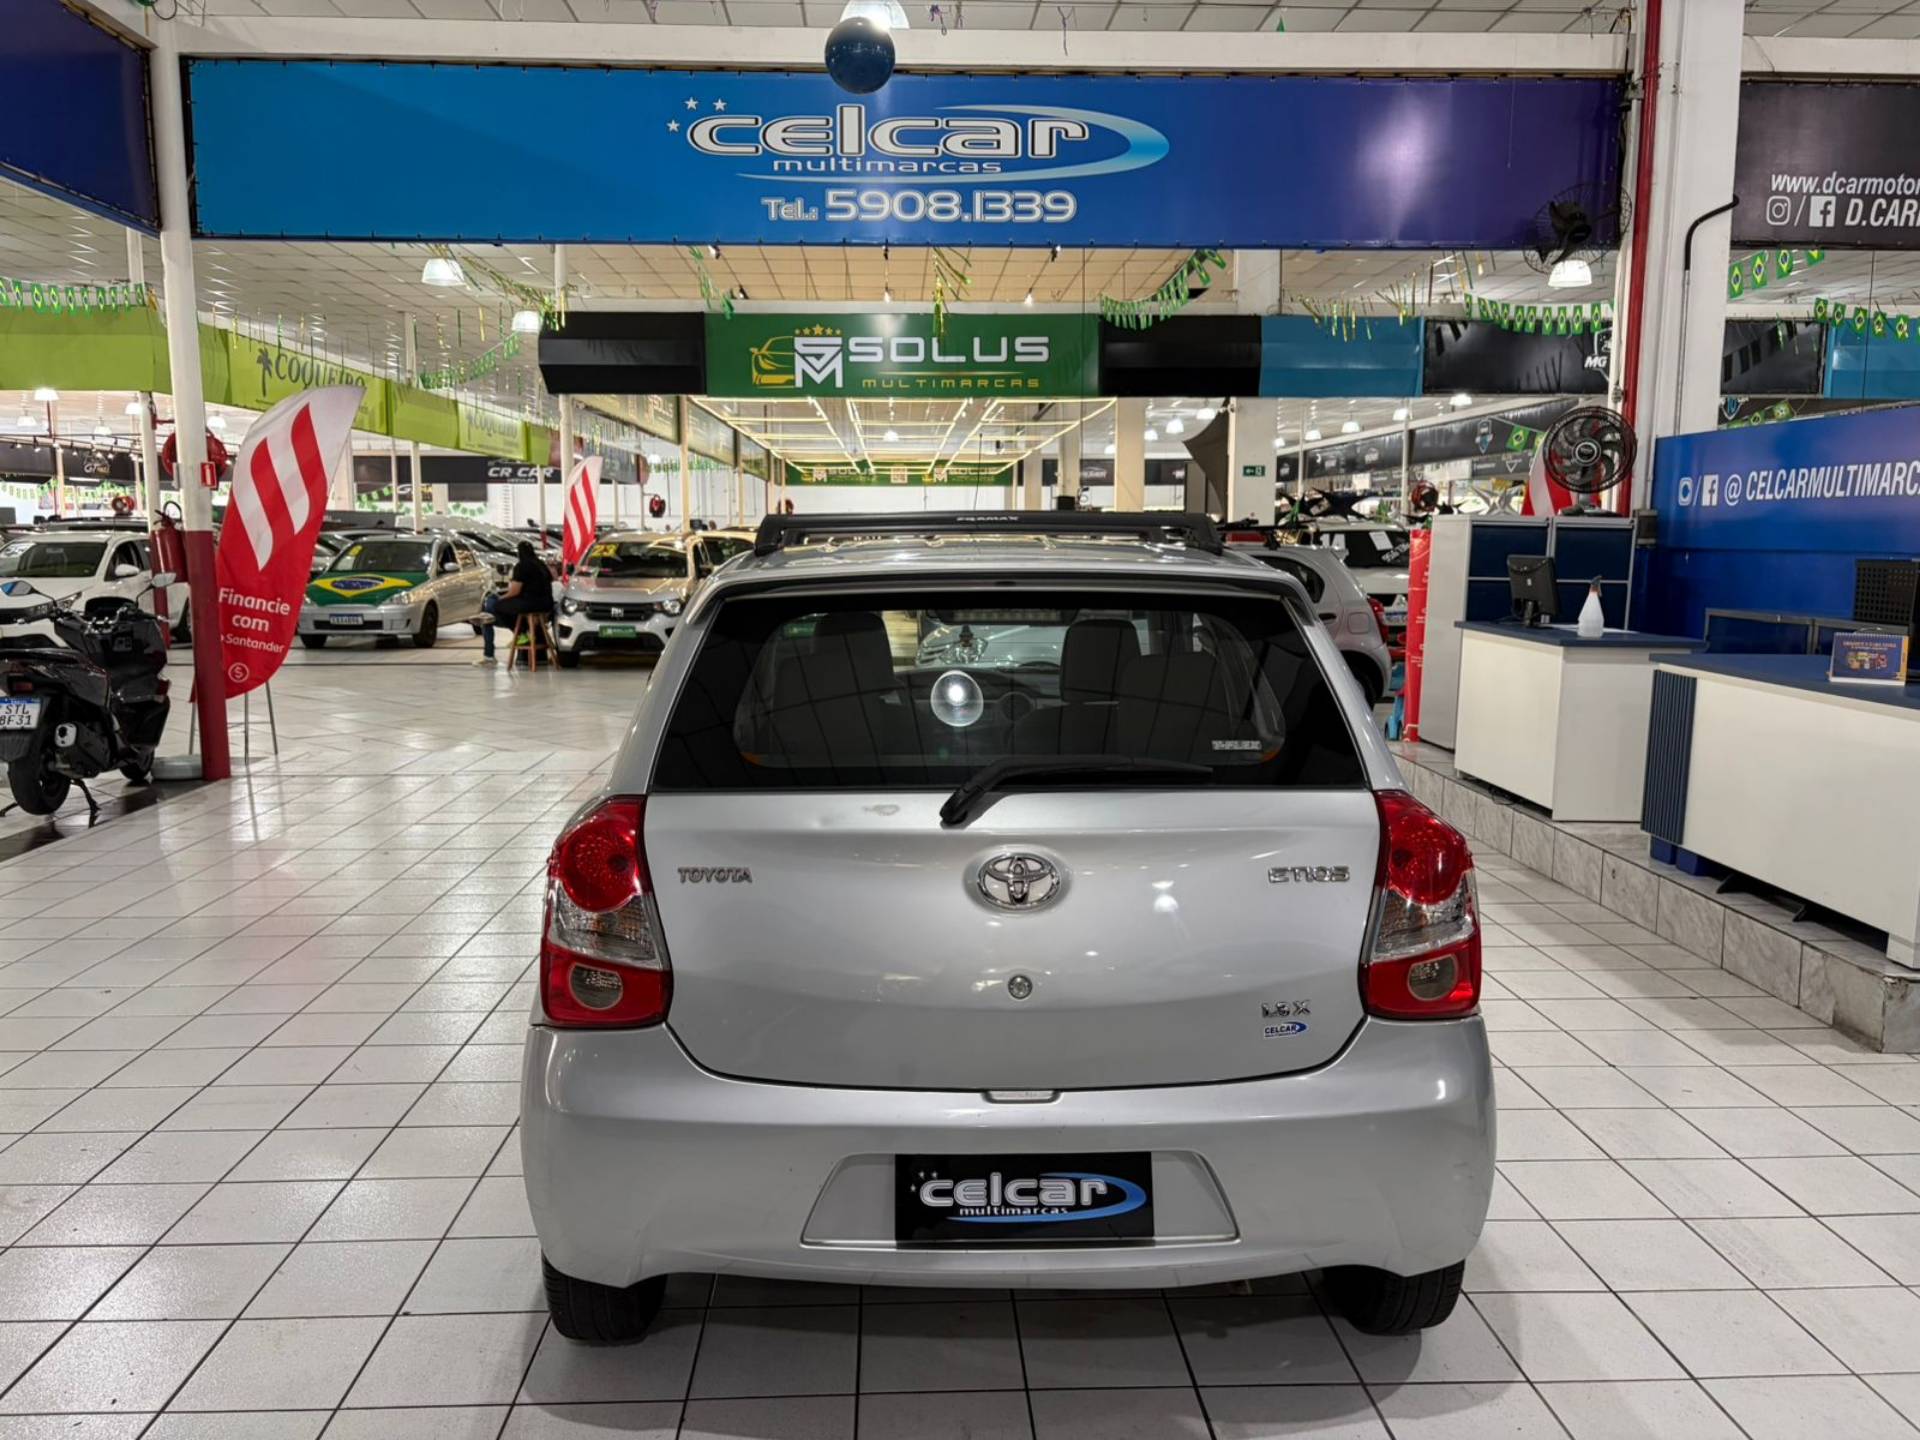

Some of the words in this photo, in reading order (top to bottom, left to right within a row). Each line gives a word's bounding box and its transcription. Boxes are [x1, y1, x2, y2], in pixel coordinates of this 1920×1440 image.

[687, 103, 1090, 159] celcar
[773, 156, 1003, 173] multimarcas
[825, 189, 1078, 222] 5908.1339
[1845, 198, 1920, 227] D.CAR
[848, 336, 1051, 363] SOLUS
[1584, 355, 1608, 368] MG
[862, 378, 1041, 389] MULTIMARCAS
[488, 467, 513, 478] CR
[517, 467, 554, 478] CAR
[1746, 460, 1920, 501] CELCARMULTIMARC
[218, 587, 291, 615] Financie
[232, 614, 270, 632] com
[225, 633, 285, 654] Santander
[677, 867, 753, 884] TOYOTA
[1268, 866, 1350, 884] ETIOS
[918, 1172, 1108, 1208] celcar
[959, 1206, 1069, 1217] multimarcas
